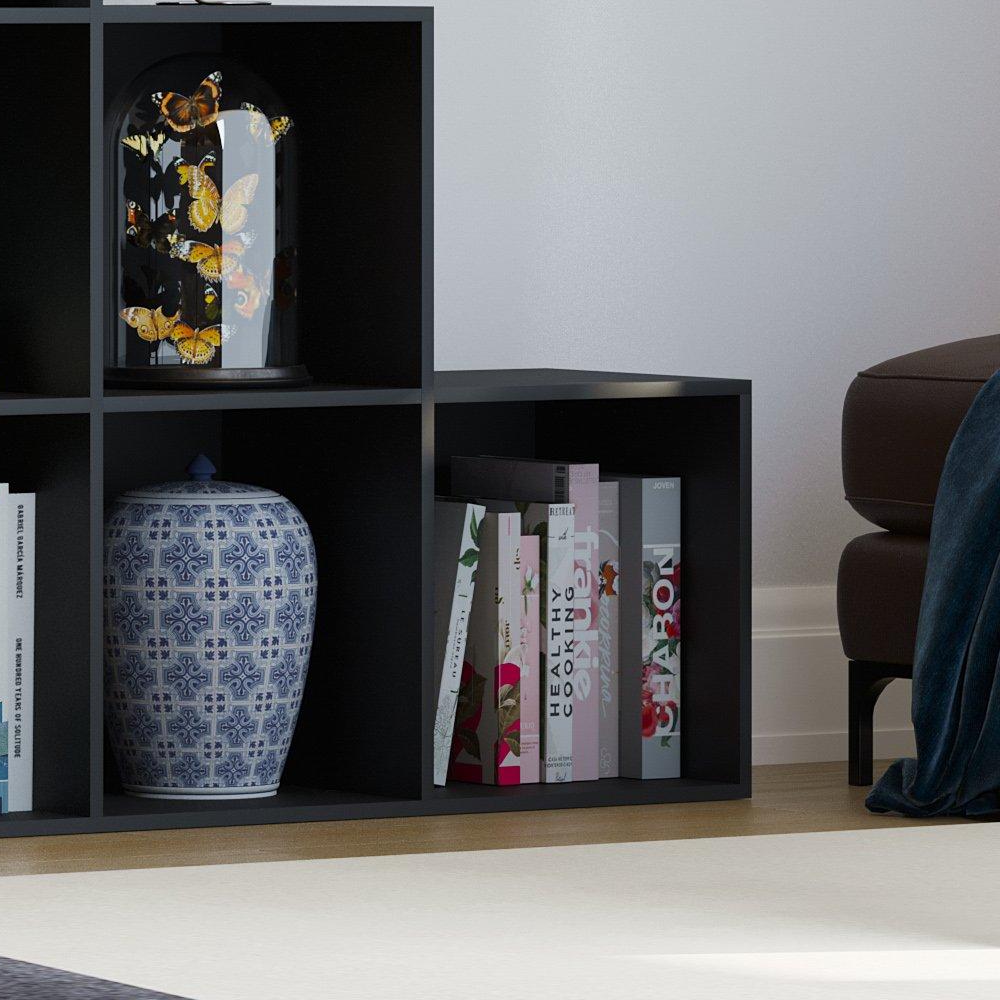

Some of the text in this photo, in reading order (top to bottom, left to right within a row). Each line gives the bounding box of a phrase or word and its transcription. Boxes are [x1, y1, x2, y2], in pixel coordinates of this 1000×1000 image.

[653, 481, 675, 490] JOVEN
[15, 504, 25, 599] GABRIEL GARCÍA MÁRQUEZ
[15, 637, 23, 652] ONE
[573, 525, 599, 701] frankie
[650, 547, 676, 737] CHARBON
[15, 653, 23, 686] HUNDRED
[550, 588, 561, 718] HEALTHY
[563, 586, 575, 718] COOKING
[14, 714, 22, 722] OF
[14, 725, 22, 758] SOLITUDE
